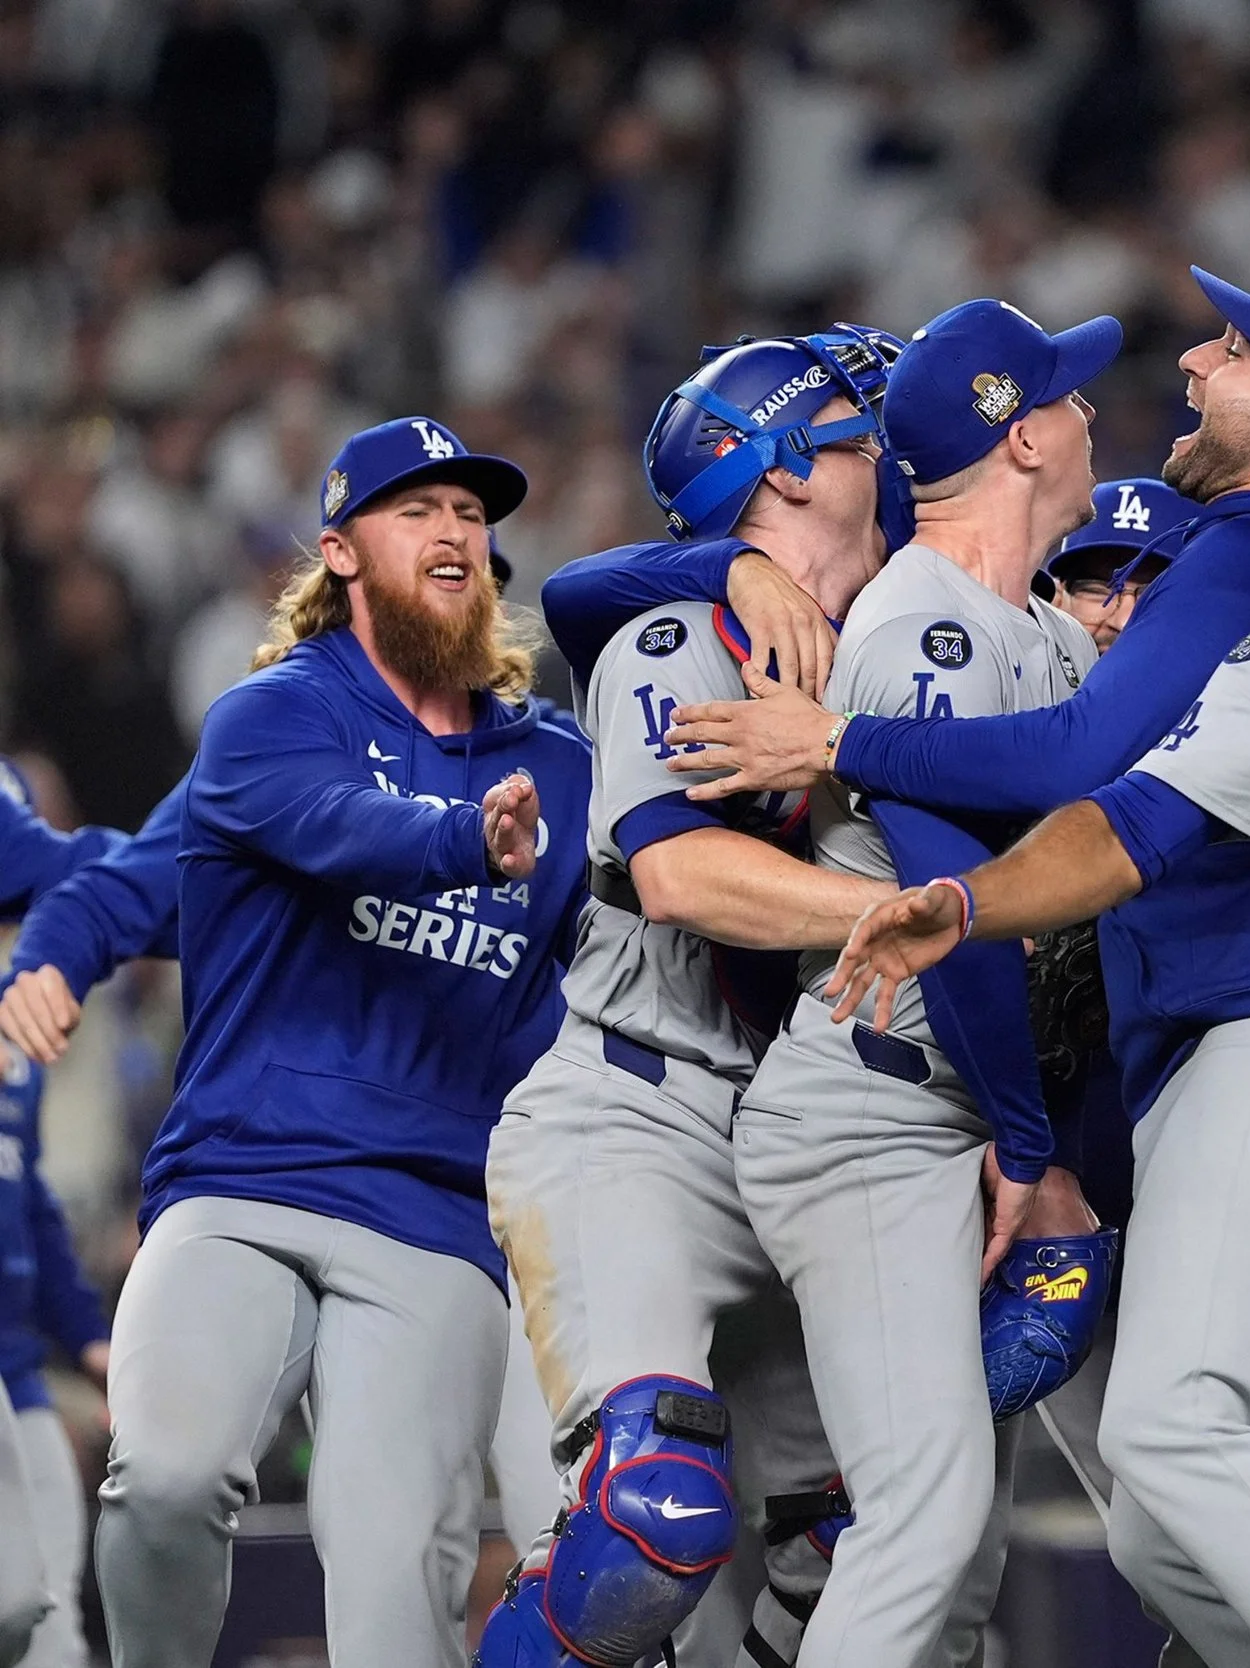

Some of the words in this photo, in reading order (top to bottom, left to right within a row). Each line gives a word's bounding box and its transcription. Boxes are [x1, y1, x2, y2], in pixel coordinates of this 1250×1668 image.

[736, 376, 806, 443] RAUSS
[978, 379, 1012, 412] WORLD
[986, 387, 1018, 419] SERIES
[411, 421, 455, 459] LA
[1112, 485, 1151, 532] LA
[645, 623, 678, 634] FERNANDO
[645, 630, 676, 651] 34
[930, 630, 964, 640] FERNANDO
[932, 638, 964, 662] 34
[349, 896, 529, 979] SERIES
[1025, 1274, 1048, 1287] WB
[1042, 1283, 1081, 1302] NIKE
